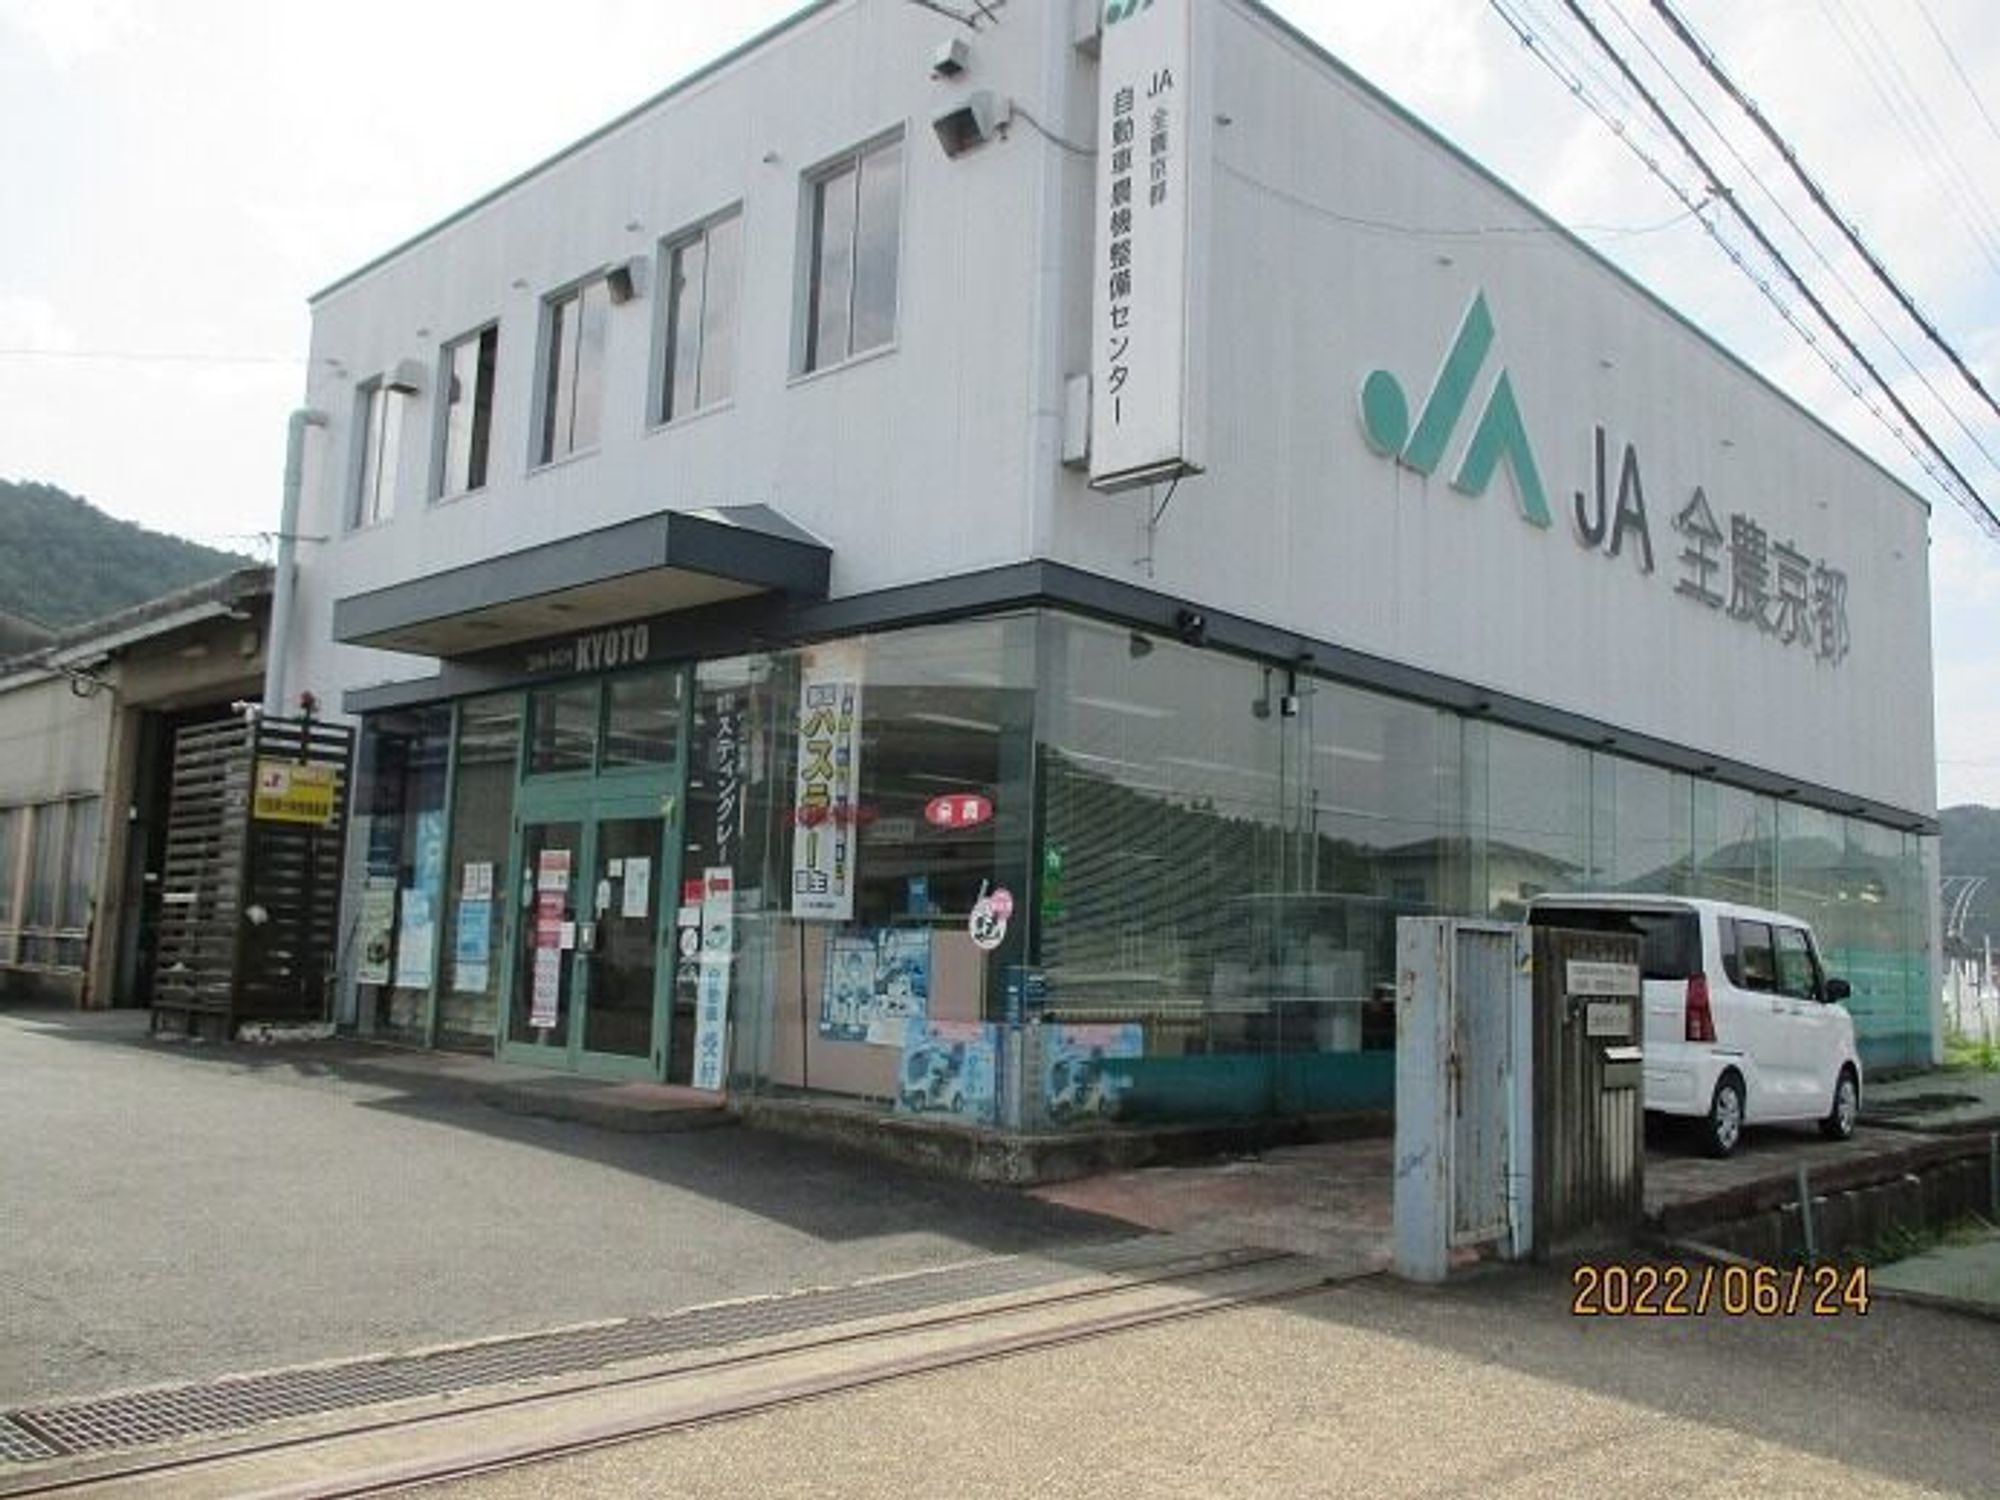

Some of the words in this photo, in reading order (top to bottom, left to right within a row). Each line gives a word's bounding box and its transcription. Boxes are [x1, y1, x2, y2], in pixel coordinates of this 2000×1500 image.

[1147, 68, 1174, 98] JA
[1574, 425, 1655, 575] JA
[1671, 485, 1850, 670] 全農京都
[575, 624, 649, 672] KYOTO
